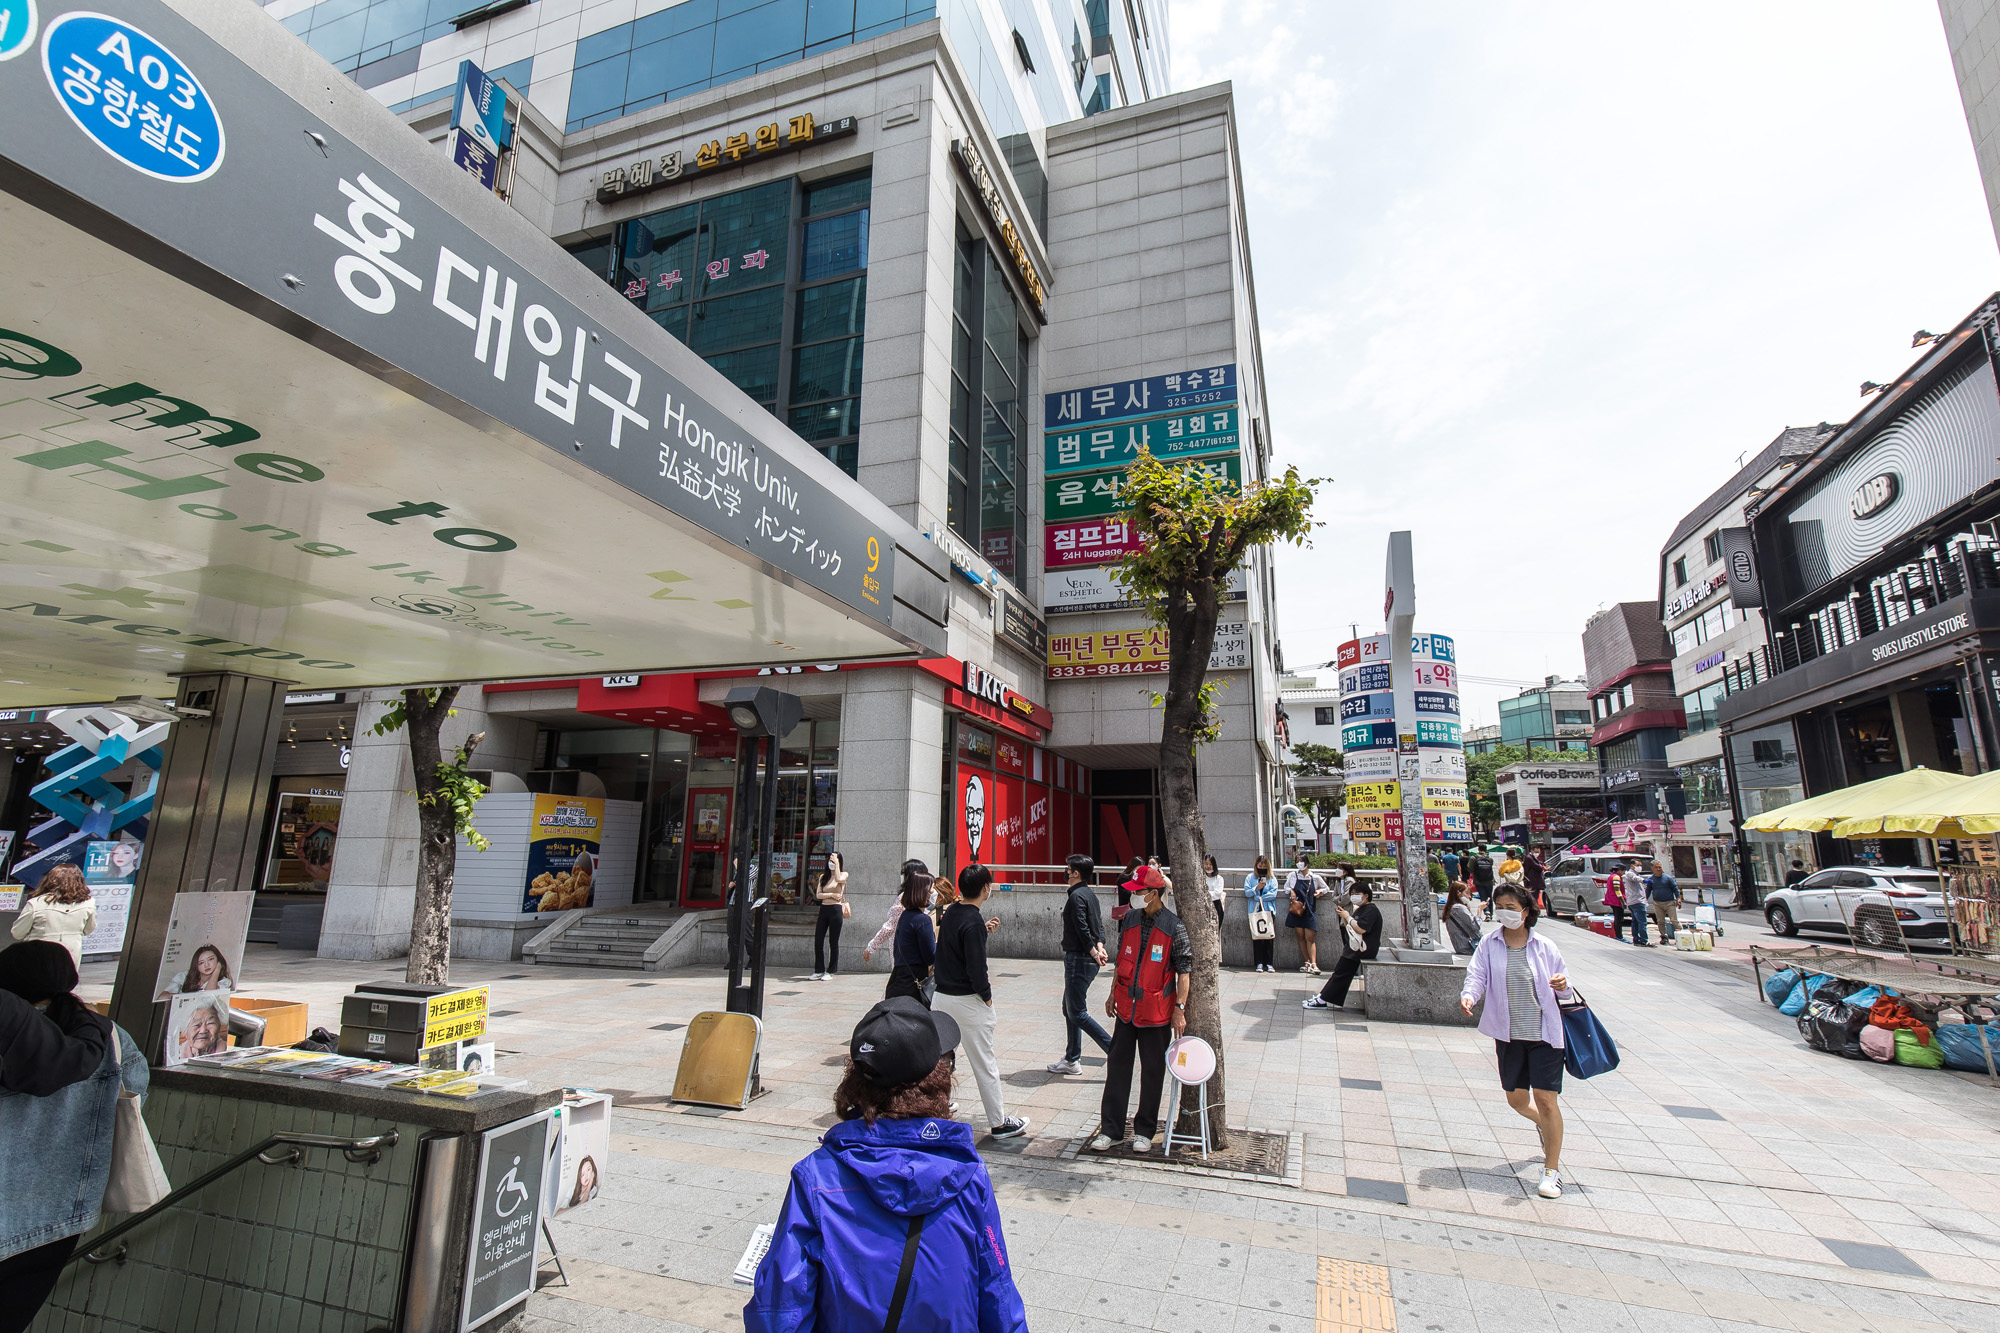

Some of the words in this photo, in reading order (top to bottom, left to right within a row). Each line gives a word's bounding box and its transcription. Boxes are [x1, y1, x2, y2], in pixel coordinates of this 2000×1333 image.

[96, 31, 197, 110] A03
[62, 53, 202, 170] 공항철도
[603, 151, 684, 194] 박혜정
[696, 113, 816, 170] 산부인과
[822, 118, 850, 134] 의원
[624, 250, 769, 298] 산부인과
[313, 172, 650, 448] 홍대입구
[1057, 381, 1150, 421] 세무사
[1165, 368, 1226, 391] 박수갑
[1168, 391, 1221, 408] 325-5252
[664, 394, 749, 482] Hongik
[754, 457, 799, 515] Univ.
[1057, 425, 1150, 464] 법무사
[1168, 412, 1229, 437] 김회규
[659, 442, 741, 517] 弘益大学
[1850, 475, 1890, 518] FOLDER
[366, 500, 517, 553] to
[754, 506, 842, 576] ホンディック
[1053, 525, 1128, 550] 짐프리
[867, 537, 879, 572] 9
[1062, 551, 1081, 560] 24H
[1084, 547, 1123, 558] luggage
[1734, 553, 1750, 582] FOLDER
[862, 590, 880, 605] Entrance
[863, 573, 880, 593] 출입구
[1059, 587, 1102, 598] ESTHETIC
[1051, 636, 1094, 662] 백년
[1100, 629, 1169, 658] 부동산
[1364, 642, 1379, 656] 2F
[1412, 637, 1429, 653] 2F
[1872, 644, 1898, 661] SHOES
[1897, 624, 1938, 652] LIFESTYLE
[1938, 612, 1969, 638] STORE
[981, 670, 1009, 708] KFC
[968, 733, 977, 751] 24
[1031, 797, 1046, 824] KFC
[89, 853, 111, 866] 1+1
[570, 844, 587, 857] 1+1
[1256, 919, 1267, 934] C
[483, 1211, 532, 1248] 엘리베이터
[485, 1231, 526, 1263] 이용안내
[474, 1268, 498, 1286] Elevator
[498, 1251, 532, 1273] Information
